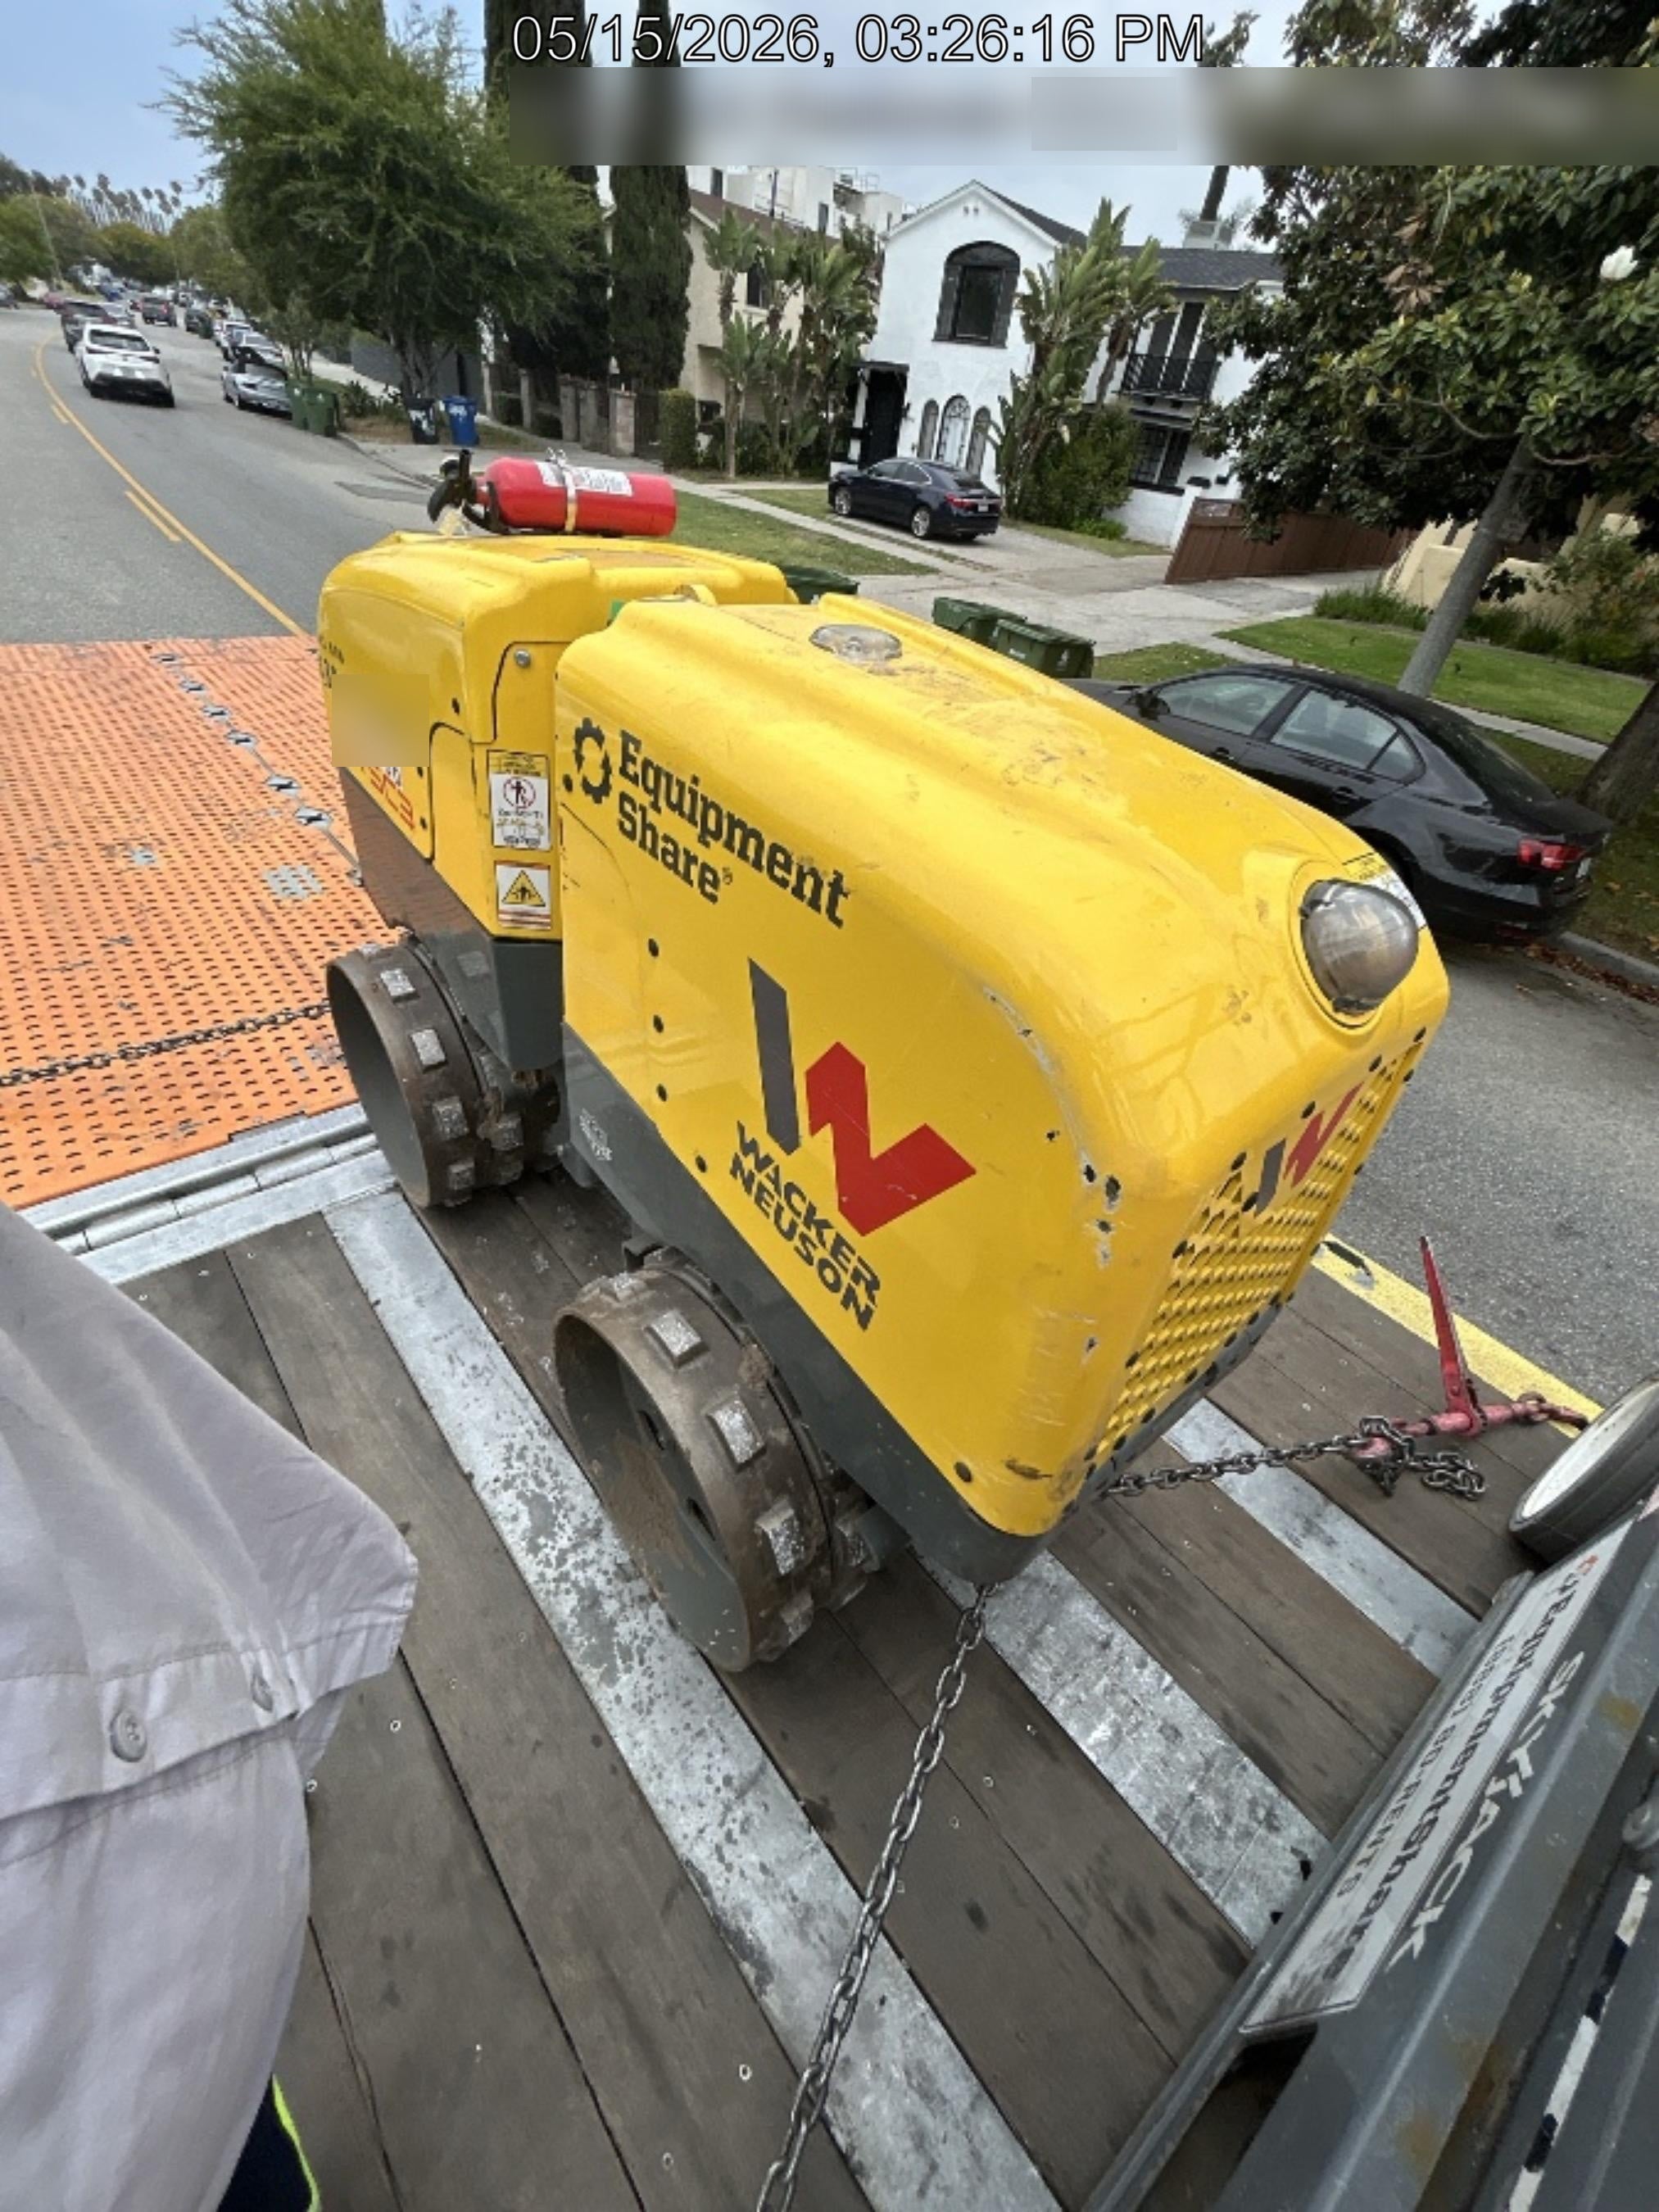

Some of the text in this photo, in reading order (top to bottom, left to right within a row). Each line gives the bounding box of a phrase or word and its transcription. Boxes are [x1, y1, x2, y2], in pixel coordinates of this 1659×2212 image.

[619, 729, 850, 929] Equipment
[729, 1152, 875, 1332] NEUSON
[737, 1119, 881, 1308] WACKER
[1322, 1588, 1577, 1977] EquipmentShare
[1384, 1651, 1585, 1974] SKYJACK
